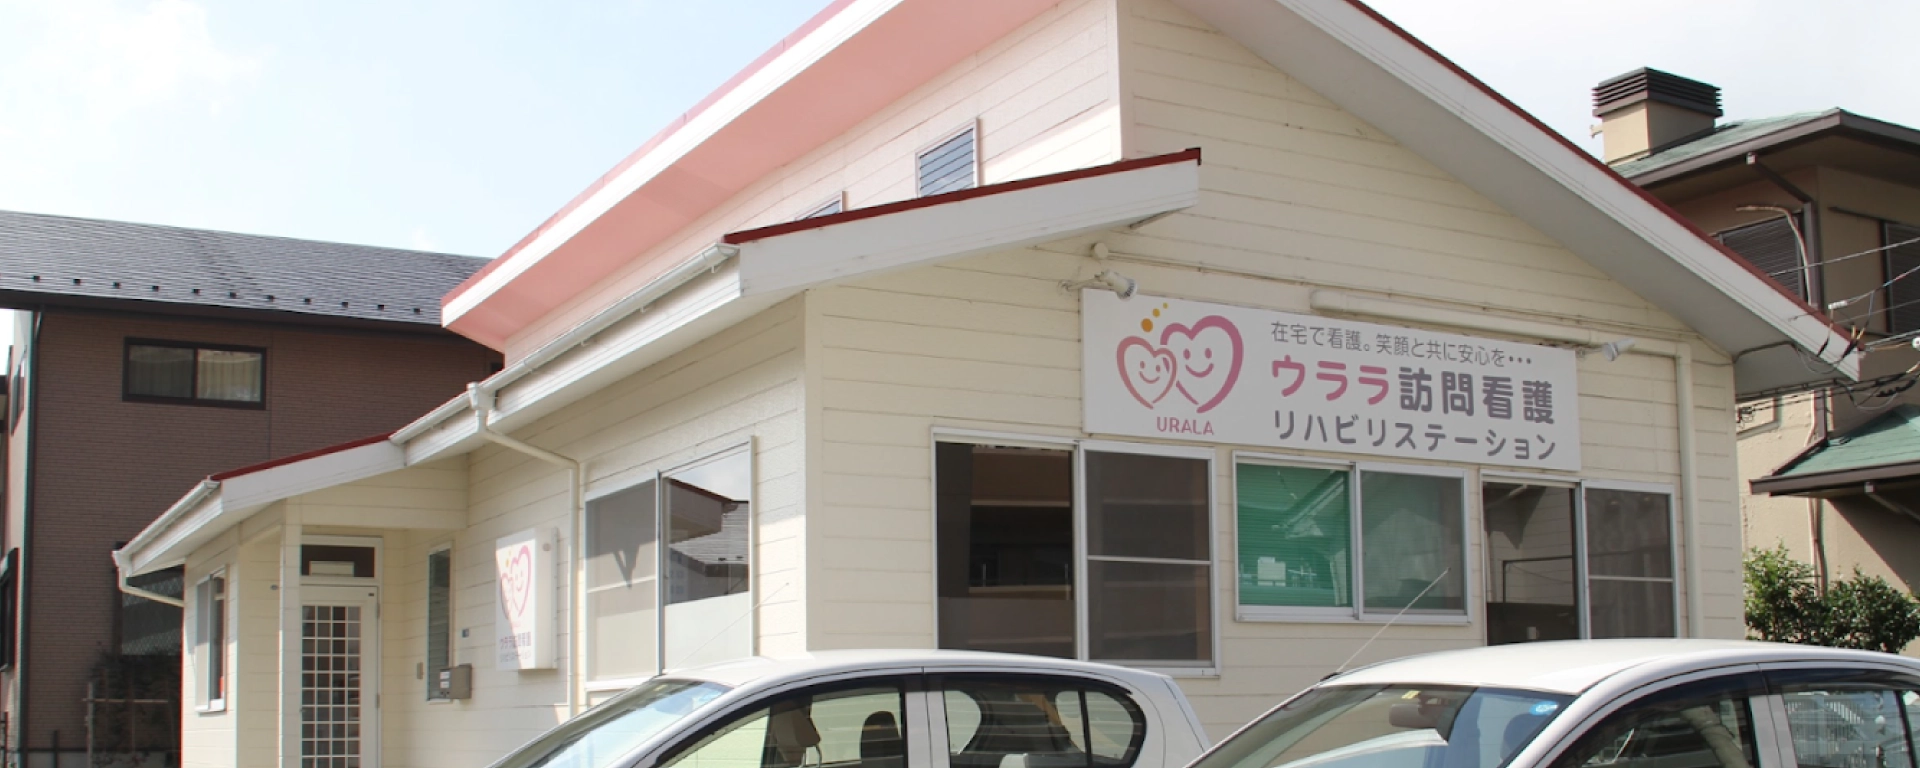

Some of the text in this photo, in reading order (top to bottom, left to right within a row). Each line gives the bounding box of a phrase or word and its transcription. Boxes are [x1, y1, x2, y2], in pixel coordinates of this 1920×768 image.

[1272, 355, 1555, 425] ウララ訪問看護
[1156, 416, 1215, 436] URALA
[1275, 410, 1556, 460] リハビリステーション
